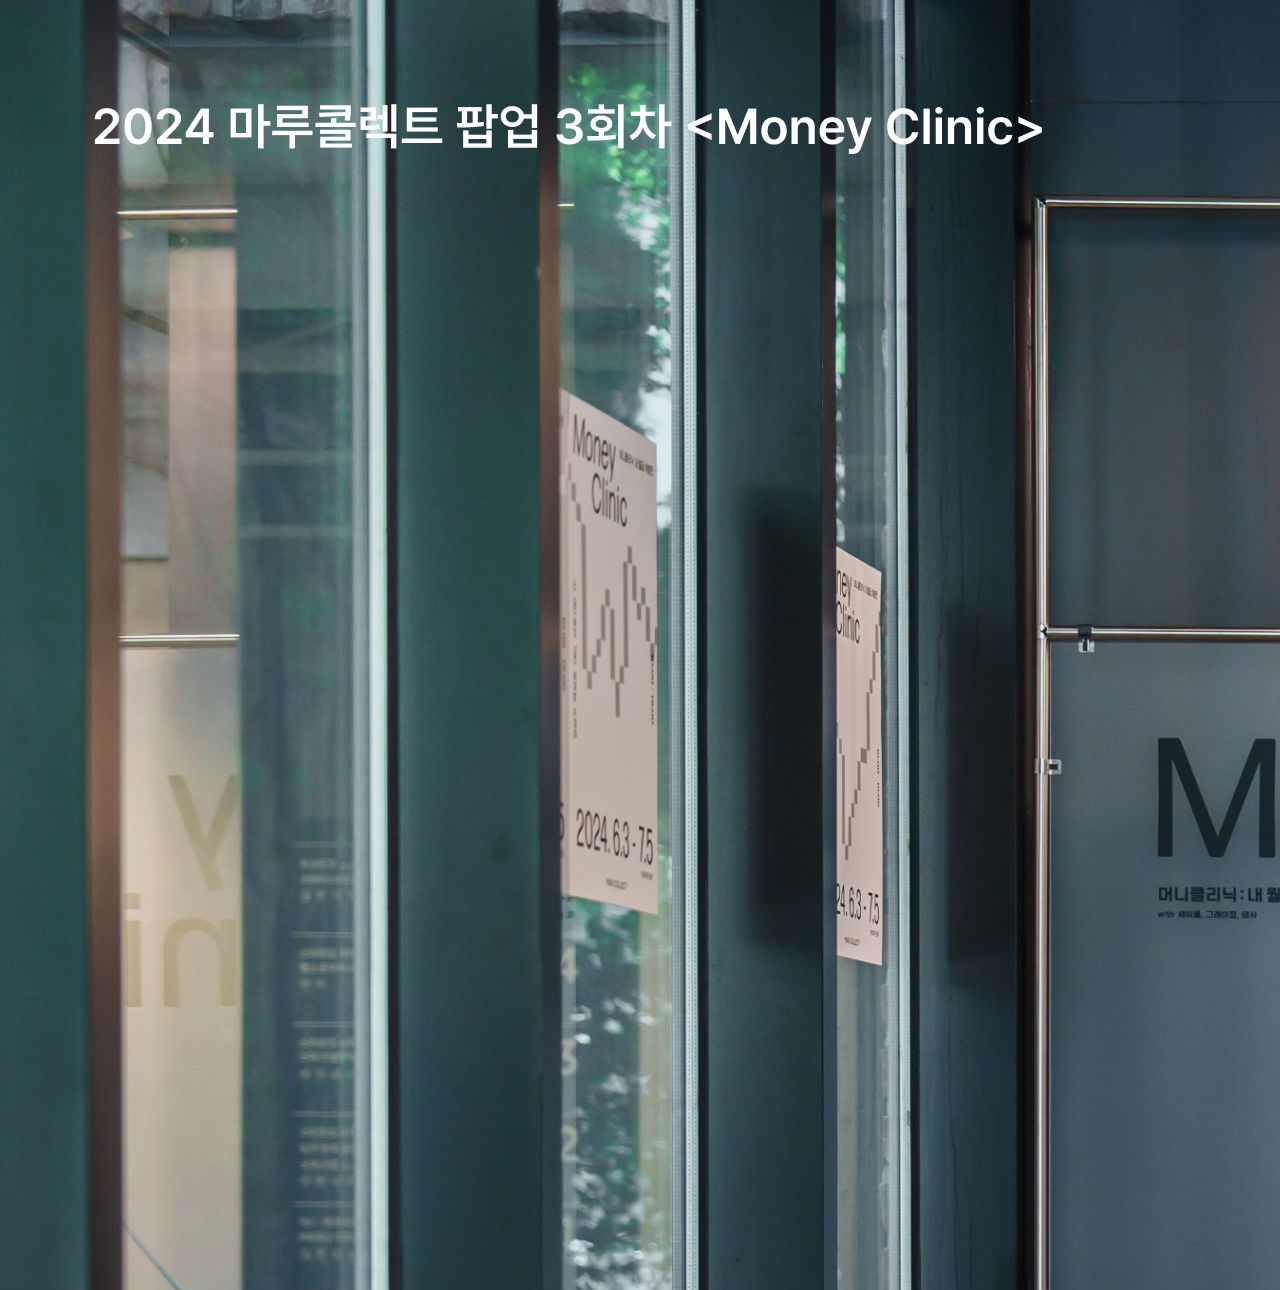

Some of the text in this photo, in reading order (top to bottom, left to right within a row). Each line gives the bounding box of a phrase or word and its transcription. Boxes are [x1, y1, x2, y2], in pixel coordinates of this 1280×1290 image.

[573, 413, 617, 483] Money
[591, 472, 628, 527] Clinic
[836, 601, 860, 644] Clinic
[576, 808, 610, 854] 2024.
[612, 818, 630, 859] 6.3
[638, 825, 654, 866] 7.5
[867, 891, 880, 925] 7.5
[1157, 910, 1175, 919] with
[1247, 886, 1263, 903] 내
